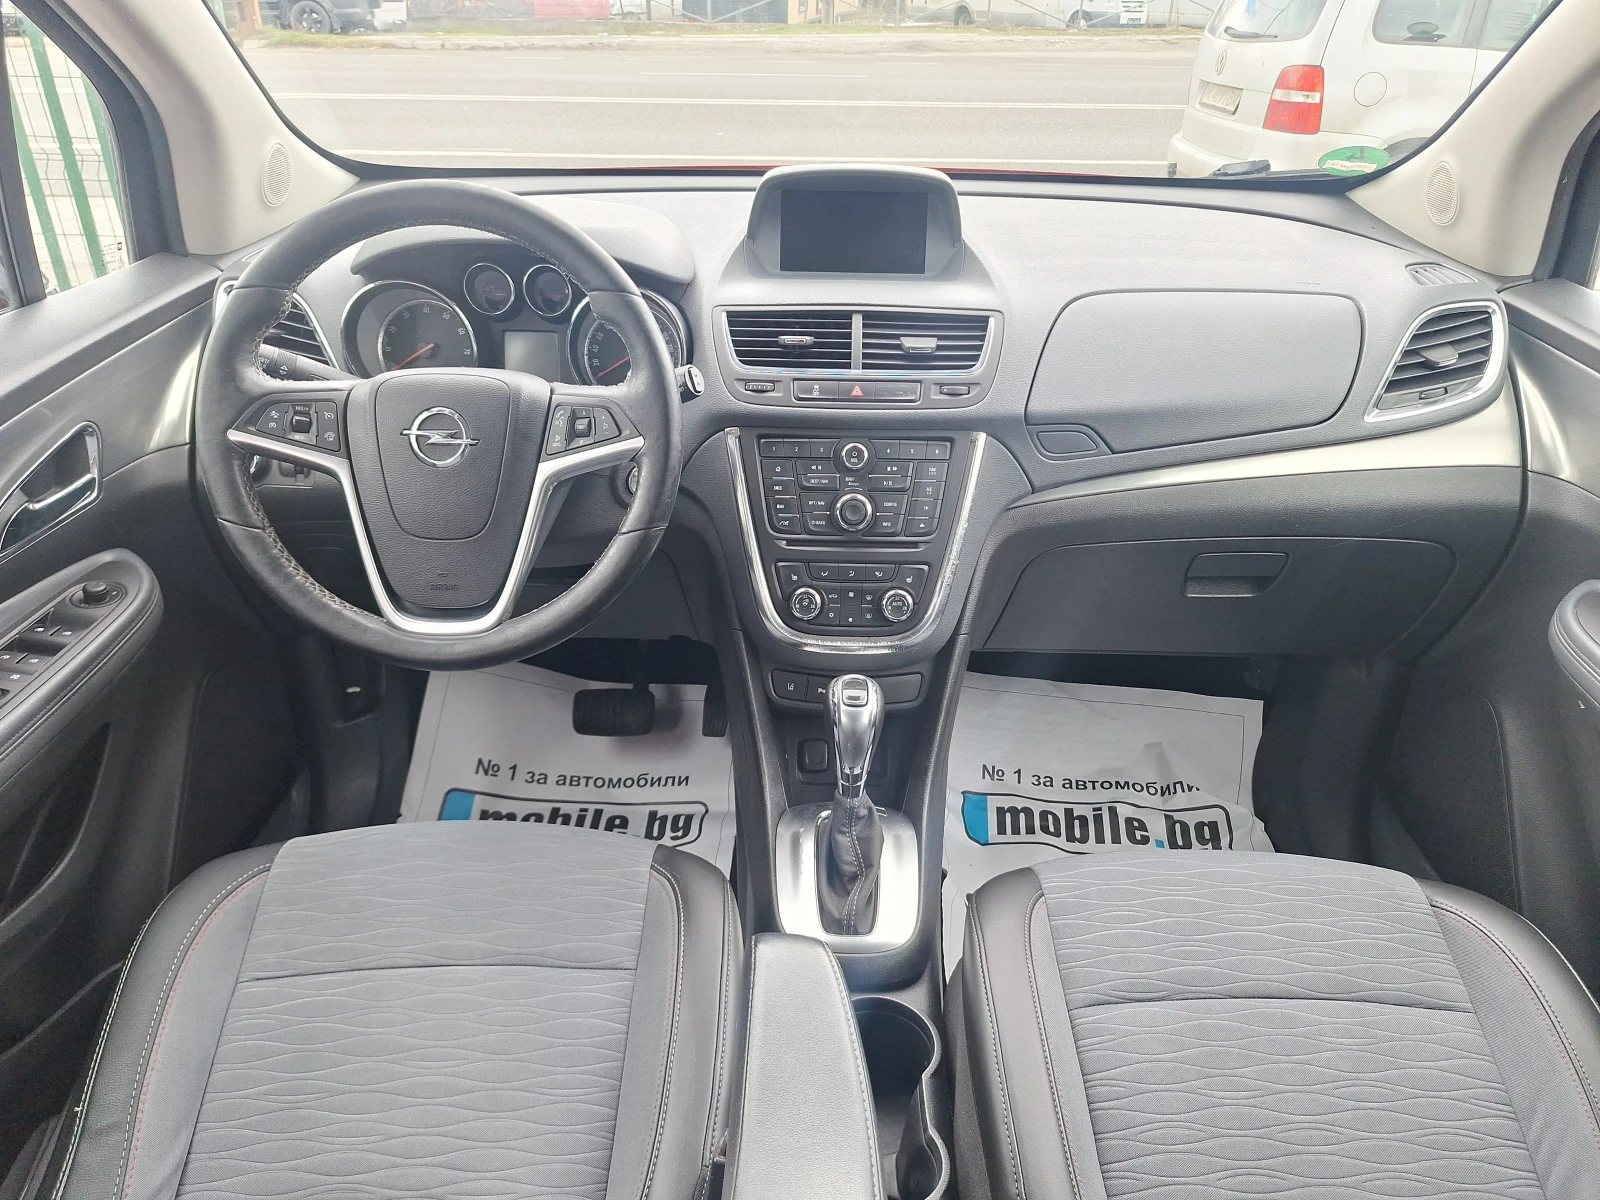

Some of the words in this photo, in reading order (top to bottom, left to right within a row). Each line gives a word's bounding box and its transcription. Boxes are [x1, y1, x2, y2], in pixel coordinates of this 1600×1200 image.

[592, 358, 600, 367] 20
[430, 583, 459, 591] AIRBAG
[475, 757, 500, 778] №
[508, 763, 518, 781] 1
[524, 770, 548, 785] за
[555, 772, 690, 789] автомобили
[981, 763, 1005, 782] №
[1013, 768, 1022, 784] 1
[1031, 774, 1054, 788] за
[995, 805, 1223, 850] mobile.bg
